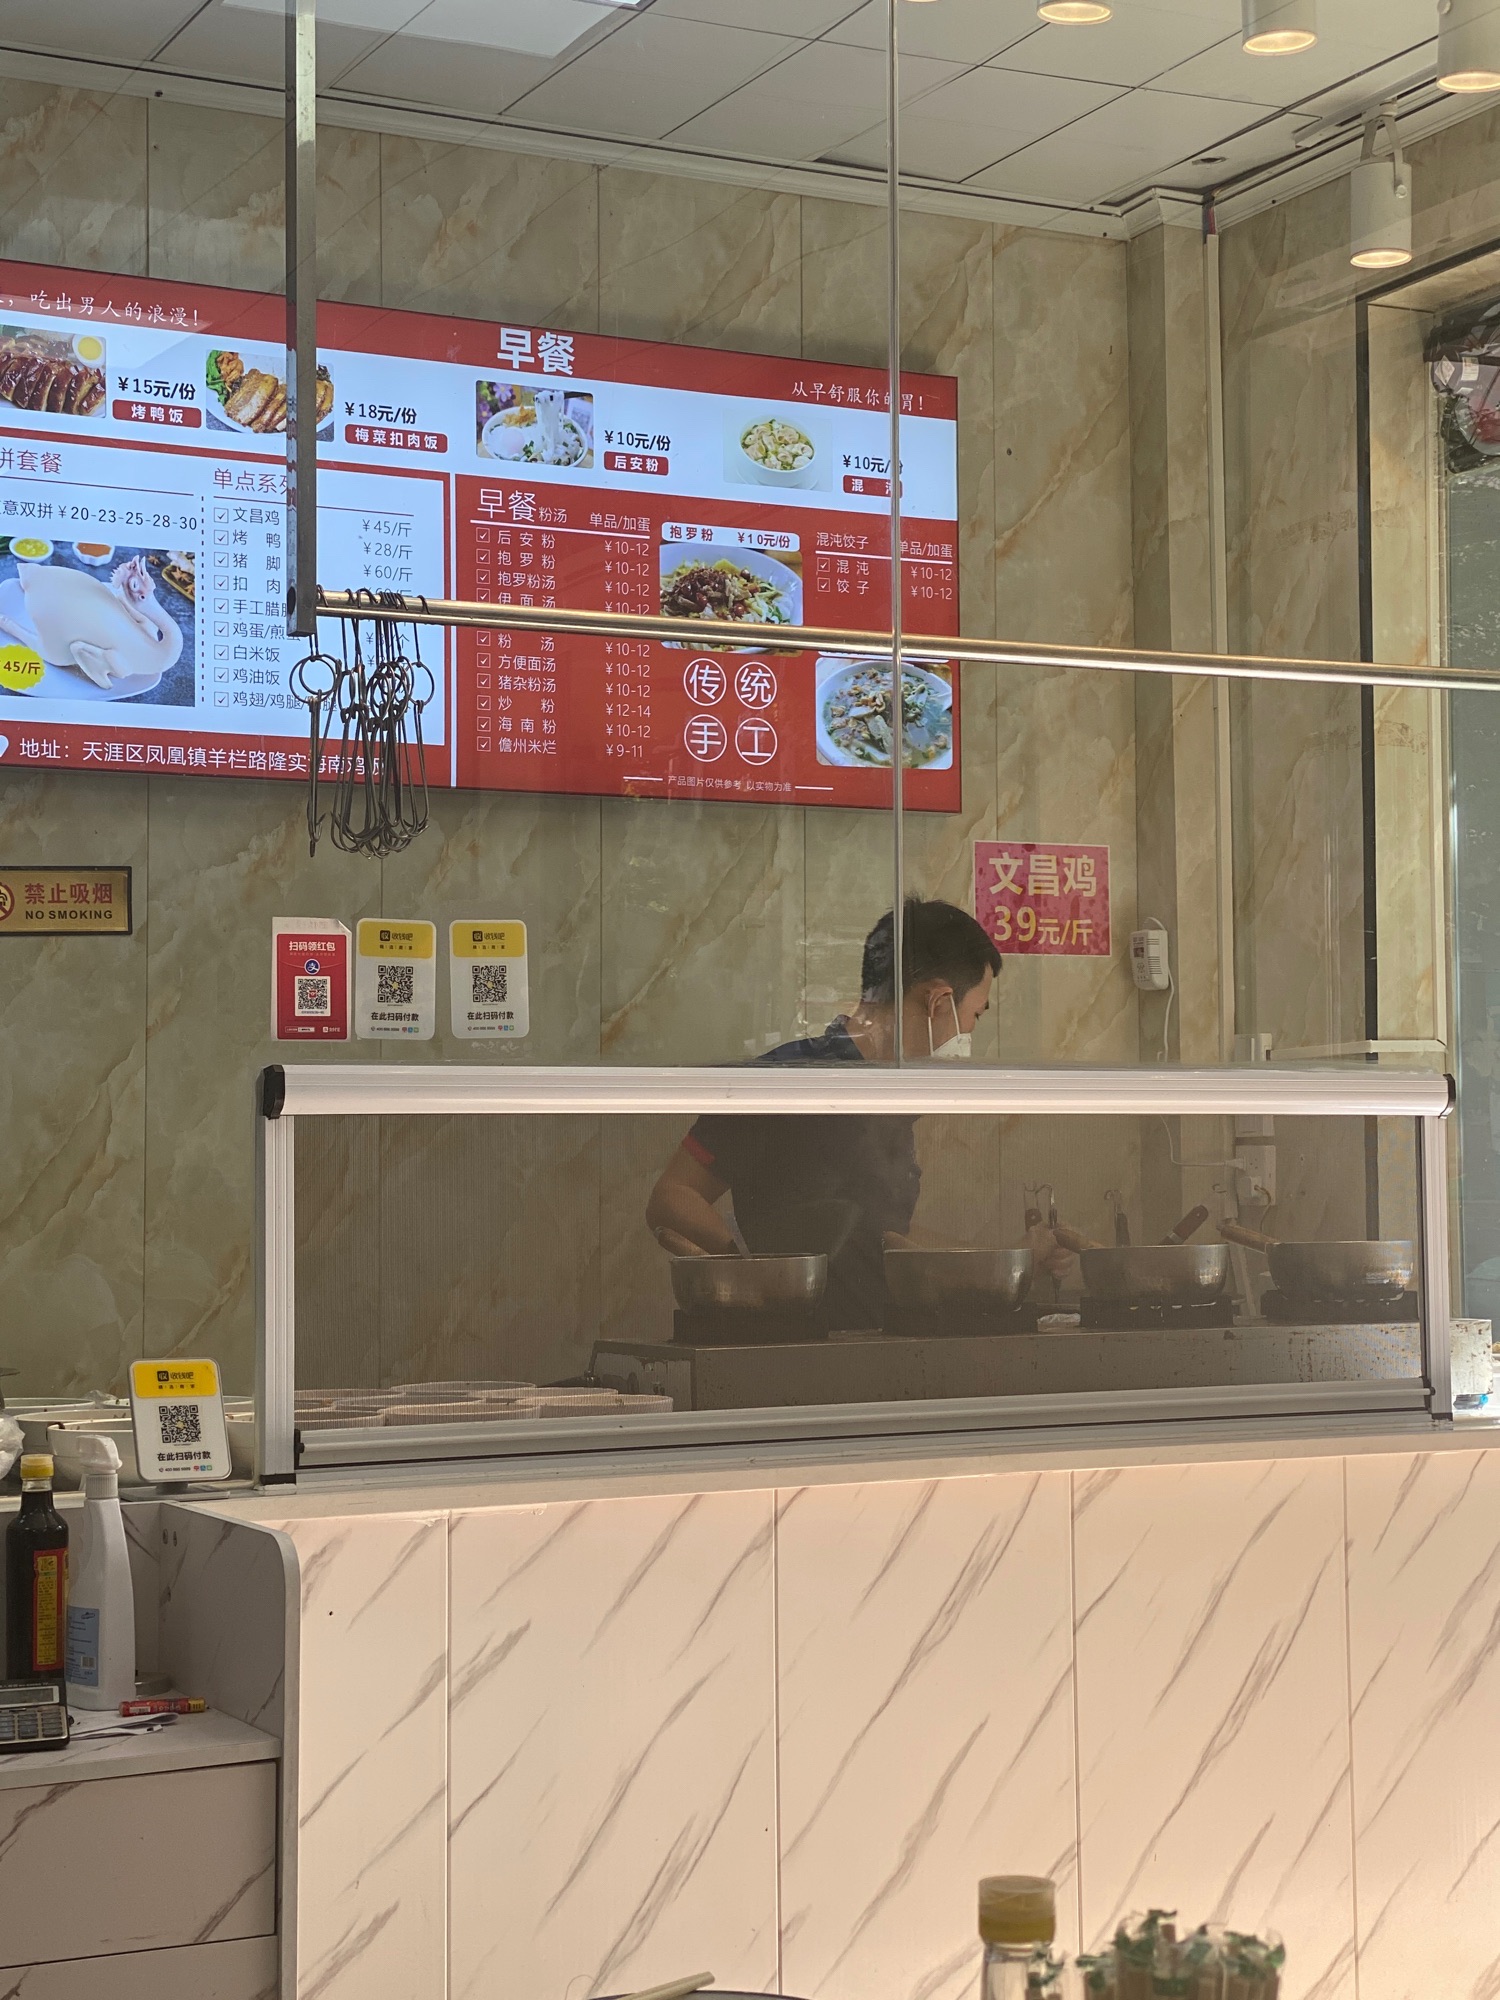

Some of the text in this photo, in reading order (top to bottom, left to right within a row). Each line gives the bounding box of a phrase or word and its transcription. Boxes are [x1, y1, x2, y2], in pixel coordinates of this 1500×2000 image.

[0, 290, 198, 327] ，吃出男人的浪漫！
[497, 327, 576, 376] 早餐
[118, 376, 196, 400] ¥15元/份
[131, 404, 184, 425] 烤鸭饭
[344, 402, 417, 425] ¥18元/份
[354, 428, 439, 451] 梅菜扣肉饭
[604, 430, 671, 451] ¥10元/份
[614, 455, 659, 473] 后安粉
[0, 499, 198, 531] 意双拼¥20-23-25-28-30
[233, 507, 412, 537] 文昌鸡 ¥45/斤
[589, 511, 650, 532] 单品/加蛋
[233, 529, 413, 560] 烤鸭 ¥28/斤
[497, 530, 650, 557] 后安粉 ¥10-12
[669, 525, 714, 542] 抱罗粉
[816, 531, 869, 551] 混沌饺子
[233, 553, 413, 583] 猪脚 ¥60/斤
[497, 550, 650, 577] 抱罗粉 ¥10-12
[836, 559, 953, 581] 混沌 ¥10-12
[233, 575, 281, 595] 扣肉
[497, 571, 650, 597] 抱罗粉汤 ¥10-12
[836, 578, 953, 600] 饺子 ¥10-12
[233, 598, 287, 618] 手工腊
[233, 622, 301, 642] 鸡蛋/煎
[233, 645, 280, 663] 白米饭
[497, 633, 651, 658] 粉汤 ¥10-12
[0, 660, 41, 675] 45/斤
[233, 667, 280, 686] 鸡油饭
[498, 654, 651, 678] 方便面汤 ¥10-12
[498, 674, 651, 698] 猪杂粉汤 ¥10-12
[689, 664, 772, 703] 传统
[498, 695, 652, 718] 炒粉 ¥12-14
[498, 716, 651, 739] 海南粉 ¥10-12
[498, 737, 643, 758] 儋州米烂 ¥9-11
[690, 721, 772, 757] 手工
[668, 775, 792, 792] 产品图片仅供参考 以实物为准
[988, 852, 1097, 897] 文昌鸡
[25, 883, 113, 905] 禁止吸烟
[25, 910, 113, 919] NO SMOKING
[994, 905, 1093, 946] 39元/斤
[289, 941, 336, 951] 扫码领红包
[371, 1012, 419, 1022] 在此扫码付款
[467, 1011, 514, 1021] 在此扫码付款
[157, 1451, 211, 1461] 在此扫码付款
